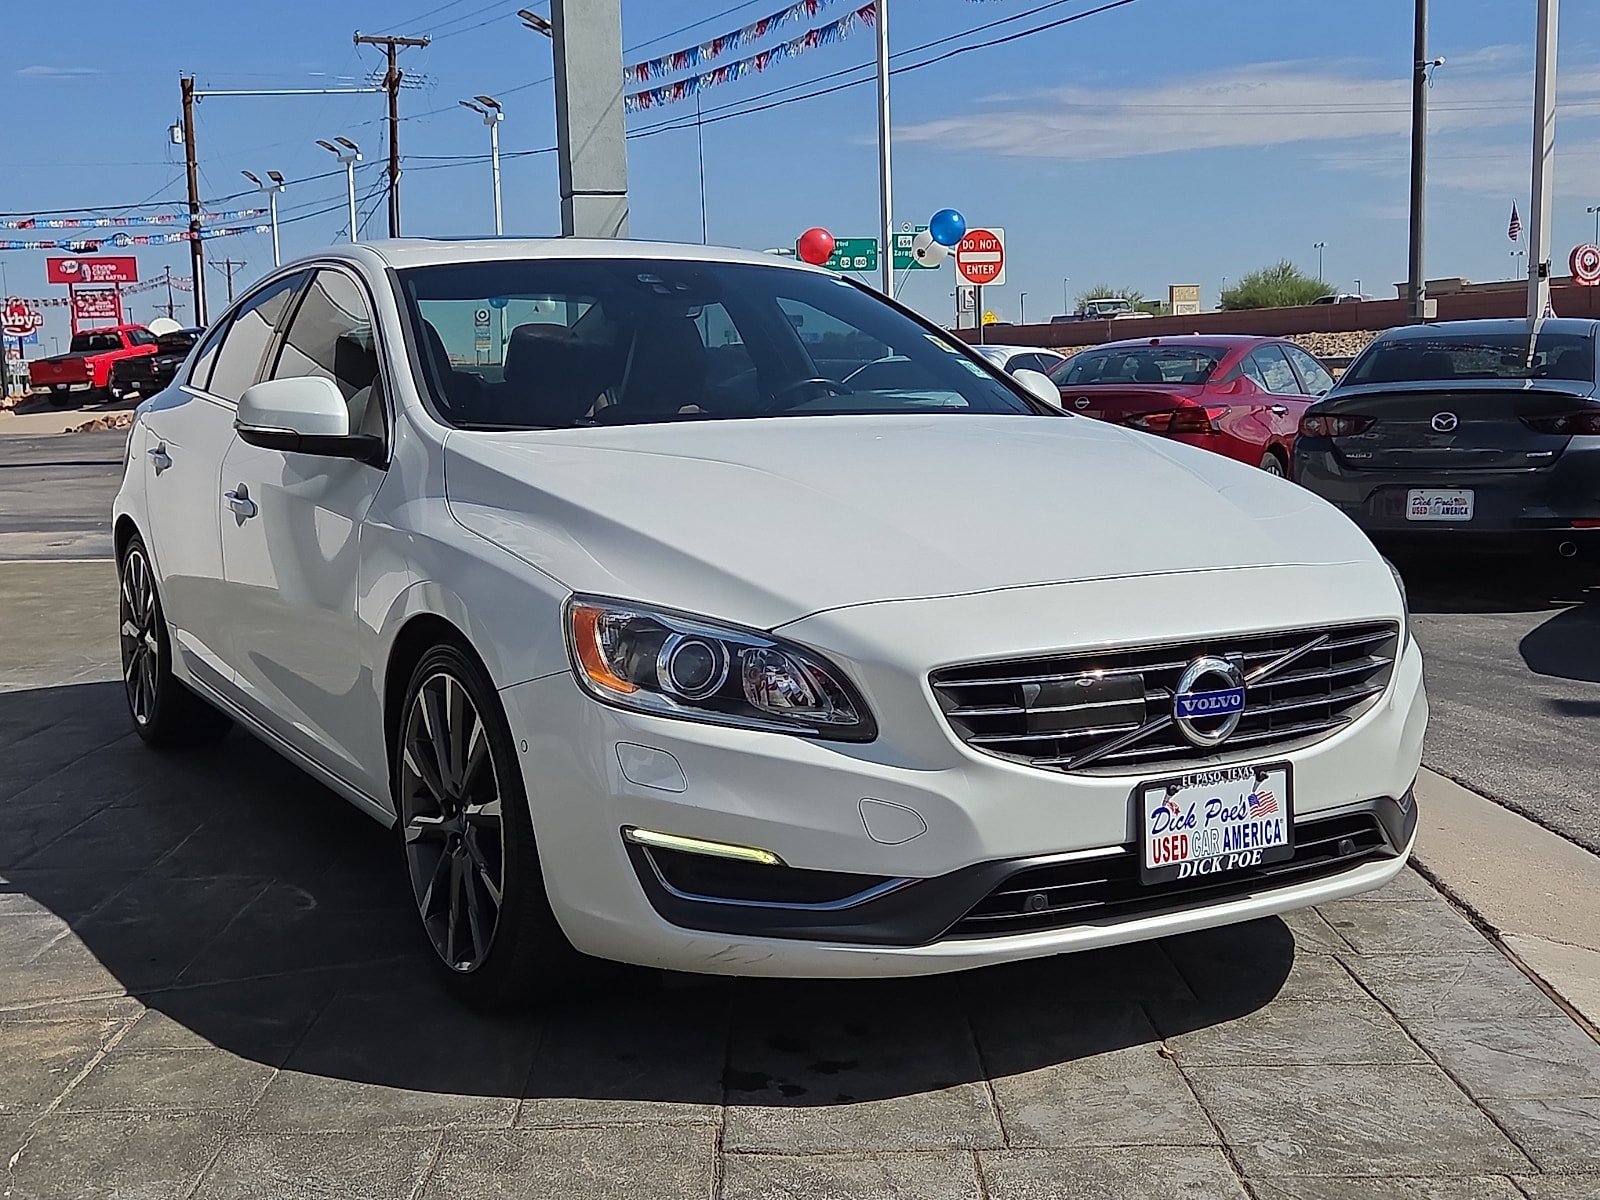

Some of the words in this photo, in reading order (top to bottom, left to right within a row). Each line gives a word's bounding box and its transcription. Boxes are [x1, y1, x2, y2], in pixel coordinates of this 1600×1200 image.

[963, 240, 975, 250] DO
[980, 239, 997, 250] NOT
[966, 264, 995, 275] ENTER
[0, 311, 43, 329] Arby's
[1412, 496, 1432, 506] Dick
[1441, 506, 1469, 515] AMERICA
[1180, 694, 1241, 712] VOLVO
[1182, 775, 1194, 787] EL
[1227, 766, 1256, 781] TEXAS
[1151, 802, 1197, 835] Dick
[1204, 794, 1248, 827] Poe's
[1152, 834, 1188, 863] USED
[1191, 828, 1220, 858] CAR
[1222, 818, 1282, 852] AMERICA
[1177, 855, 1223, 879] DICK
[1226, 848, 1264, 870] POE
